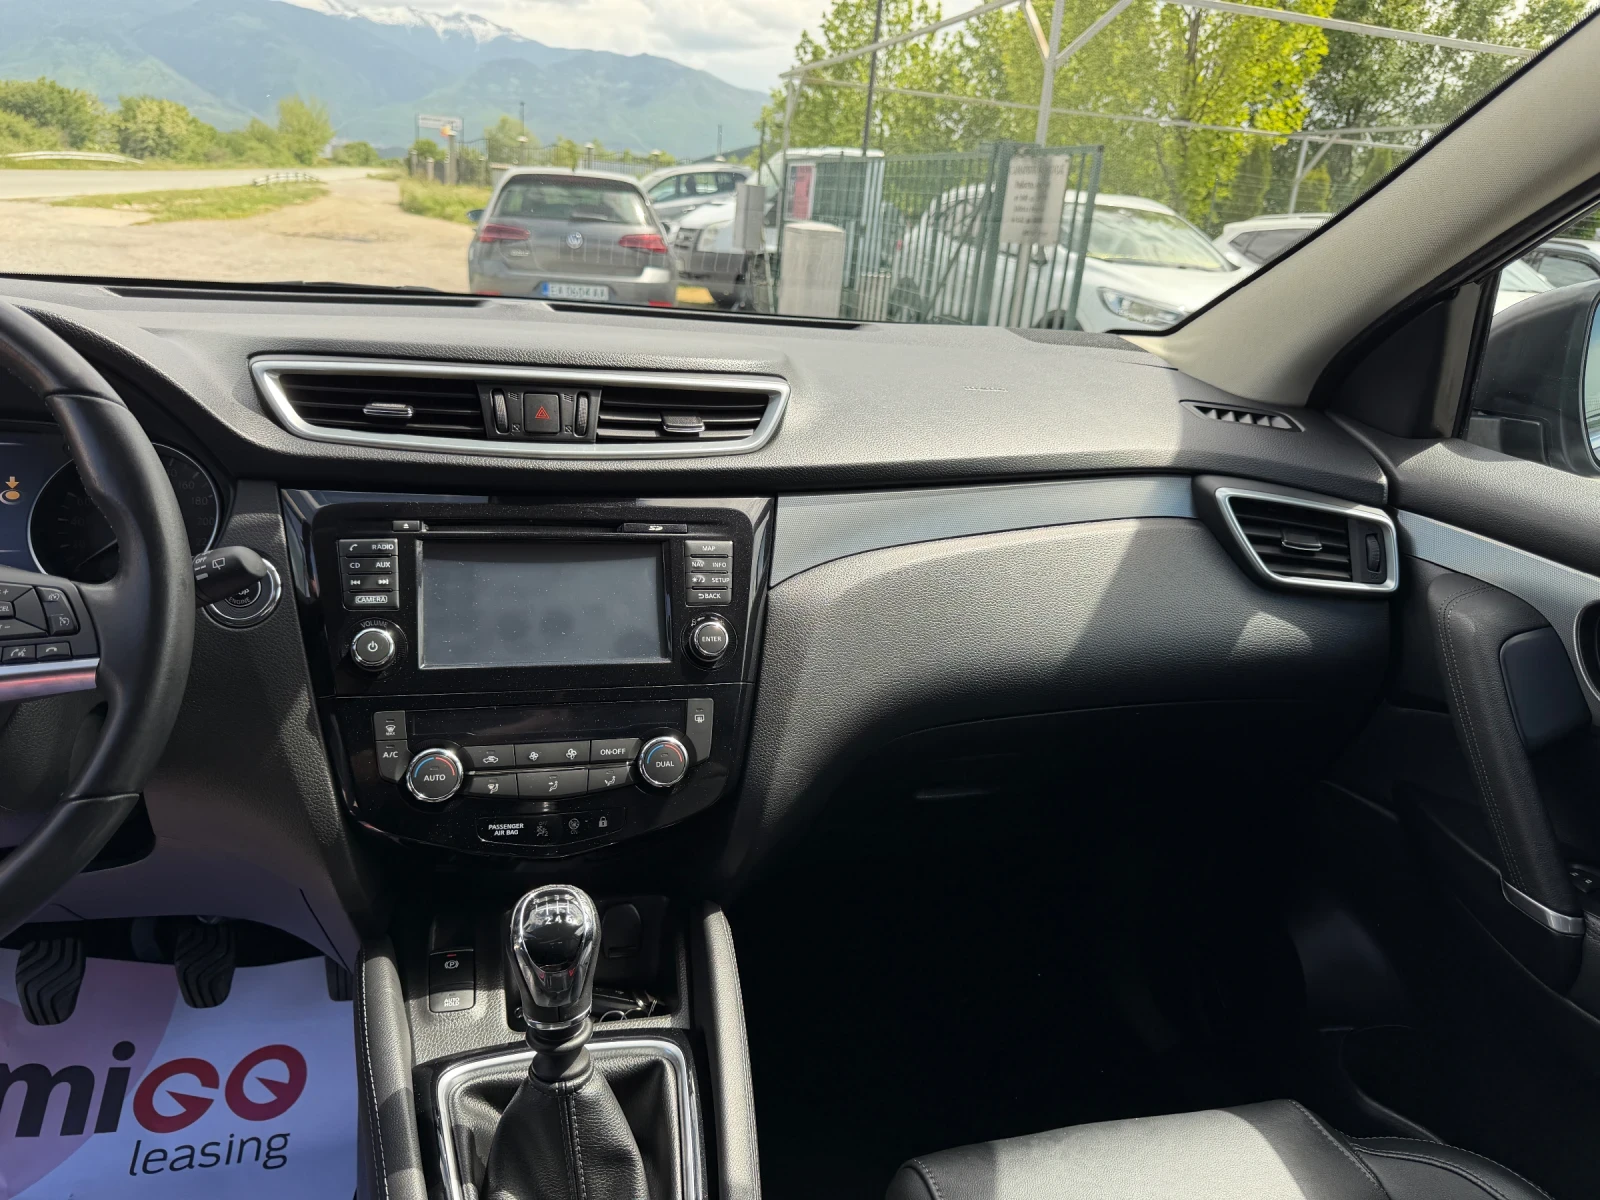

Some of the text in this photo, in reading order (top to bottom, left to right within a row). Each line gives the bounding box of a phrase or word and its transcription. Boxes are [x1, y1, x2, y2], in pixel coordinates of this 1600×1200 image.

[229, 597, 250, 605] ENGINE
[360, 620, 389, 628] VOLUME
[129, 1133, 291, 1176] leasing
